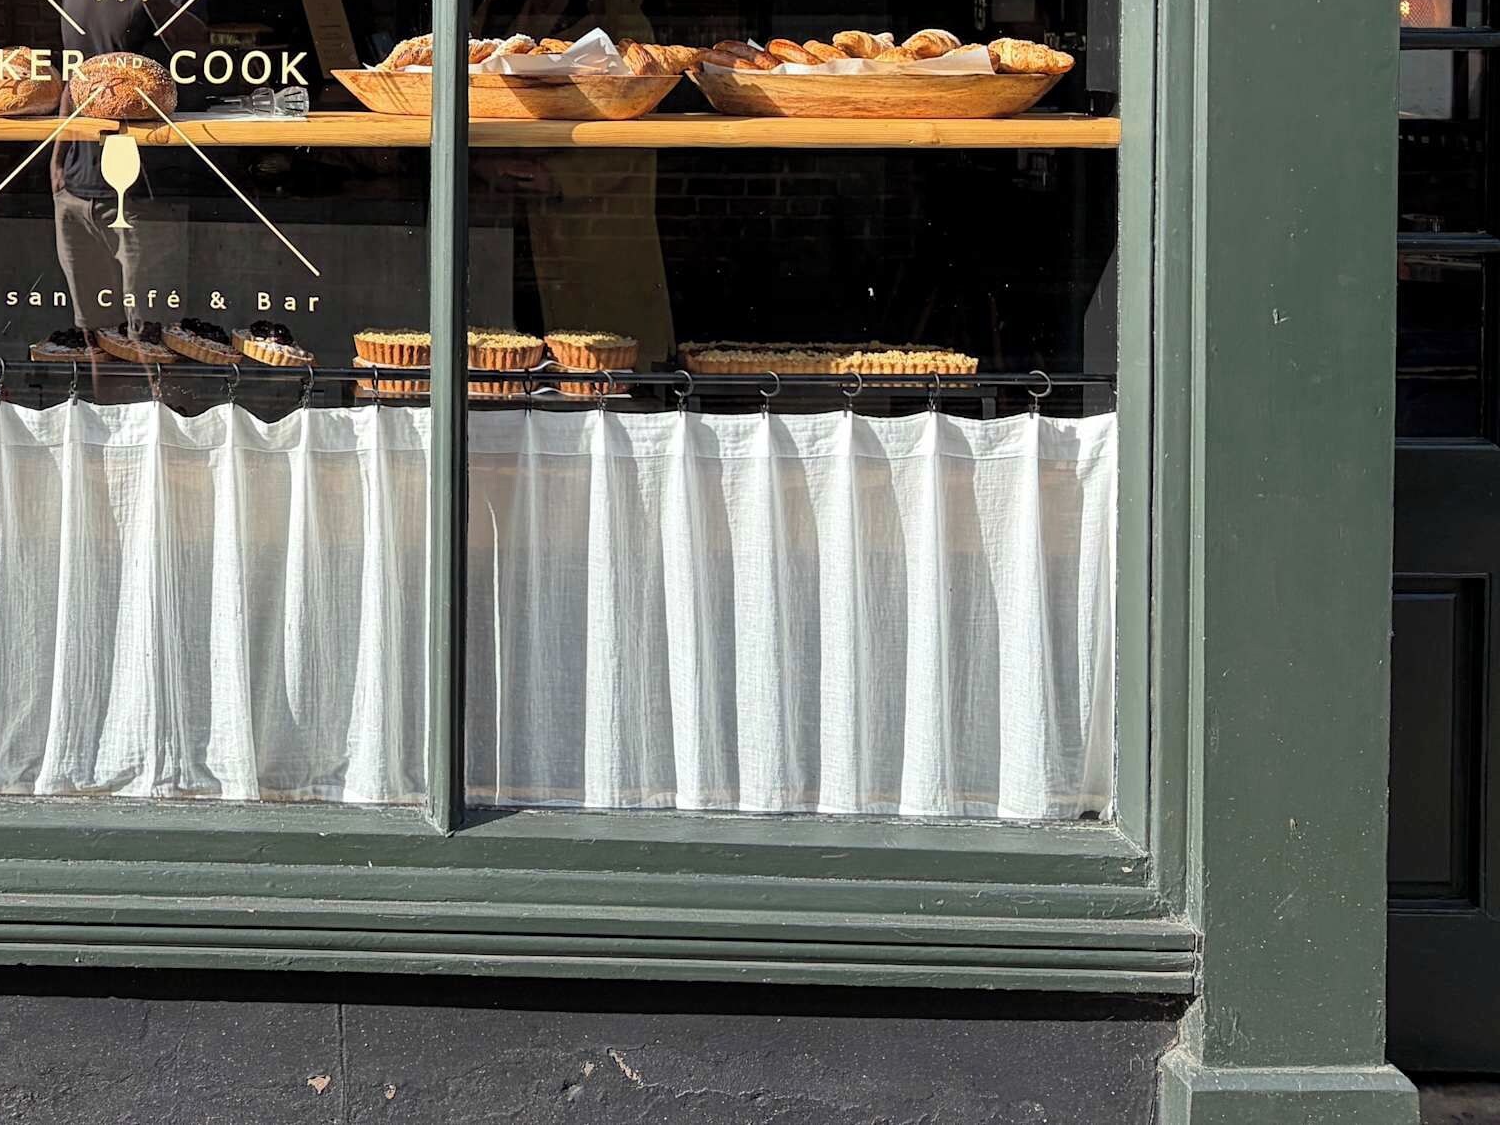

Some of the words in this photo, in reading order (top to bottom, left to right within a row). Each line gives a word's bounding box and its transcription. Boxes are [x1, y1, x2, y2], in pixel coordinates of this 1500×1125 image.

[100, 56, 143, 70] AND
[169, 50, 310, 86] COOK
[97, 288, 181, 309] Café
[209, 291, 227, 310] &
[257, 292, 320, 312] Bar
